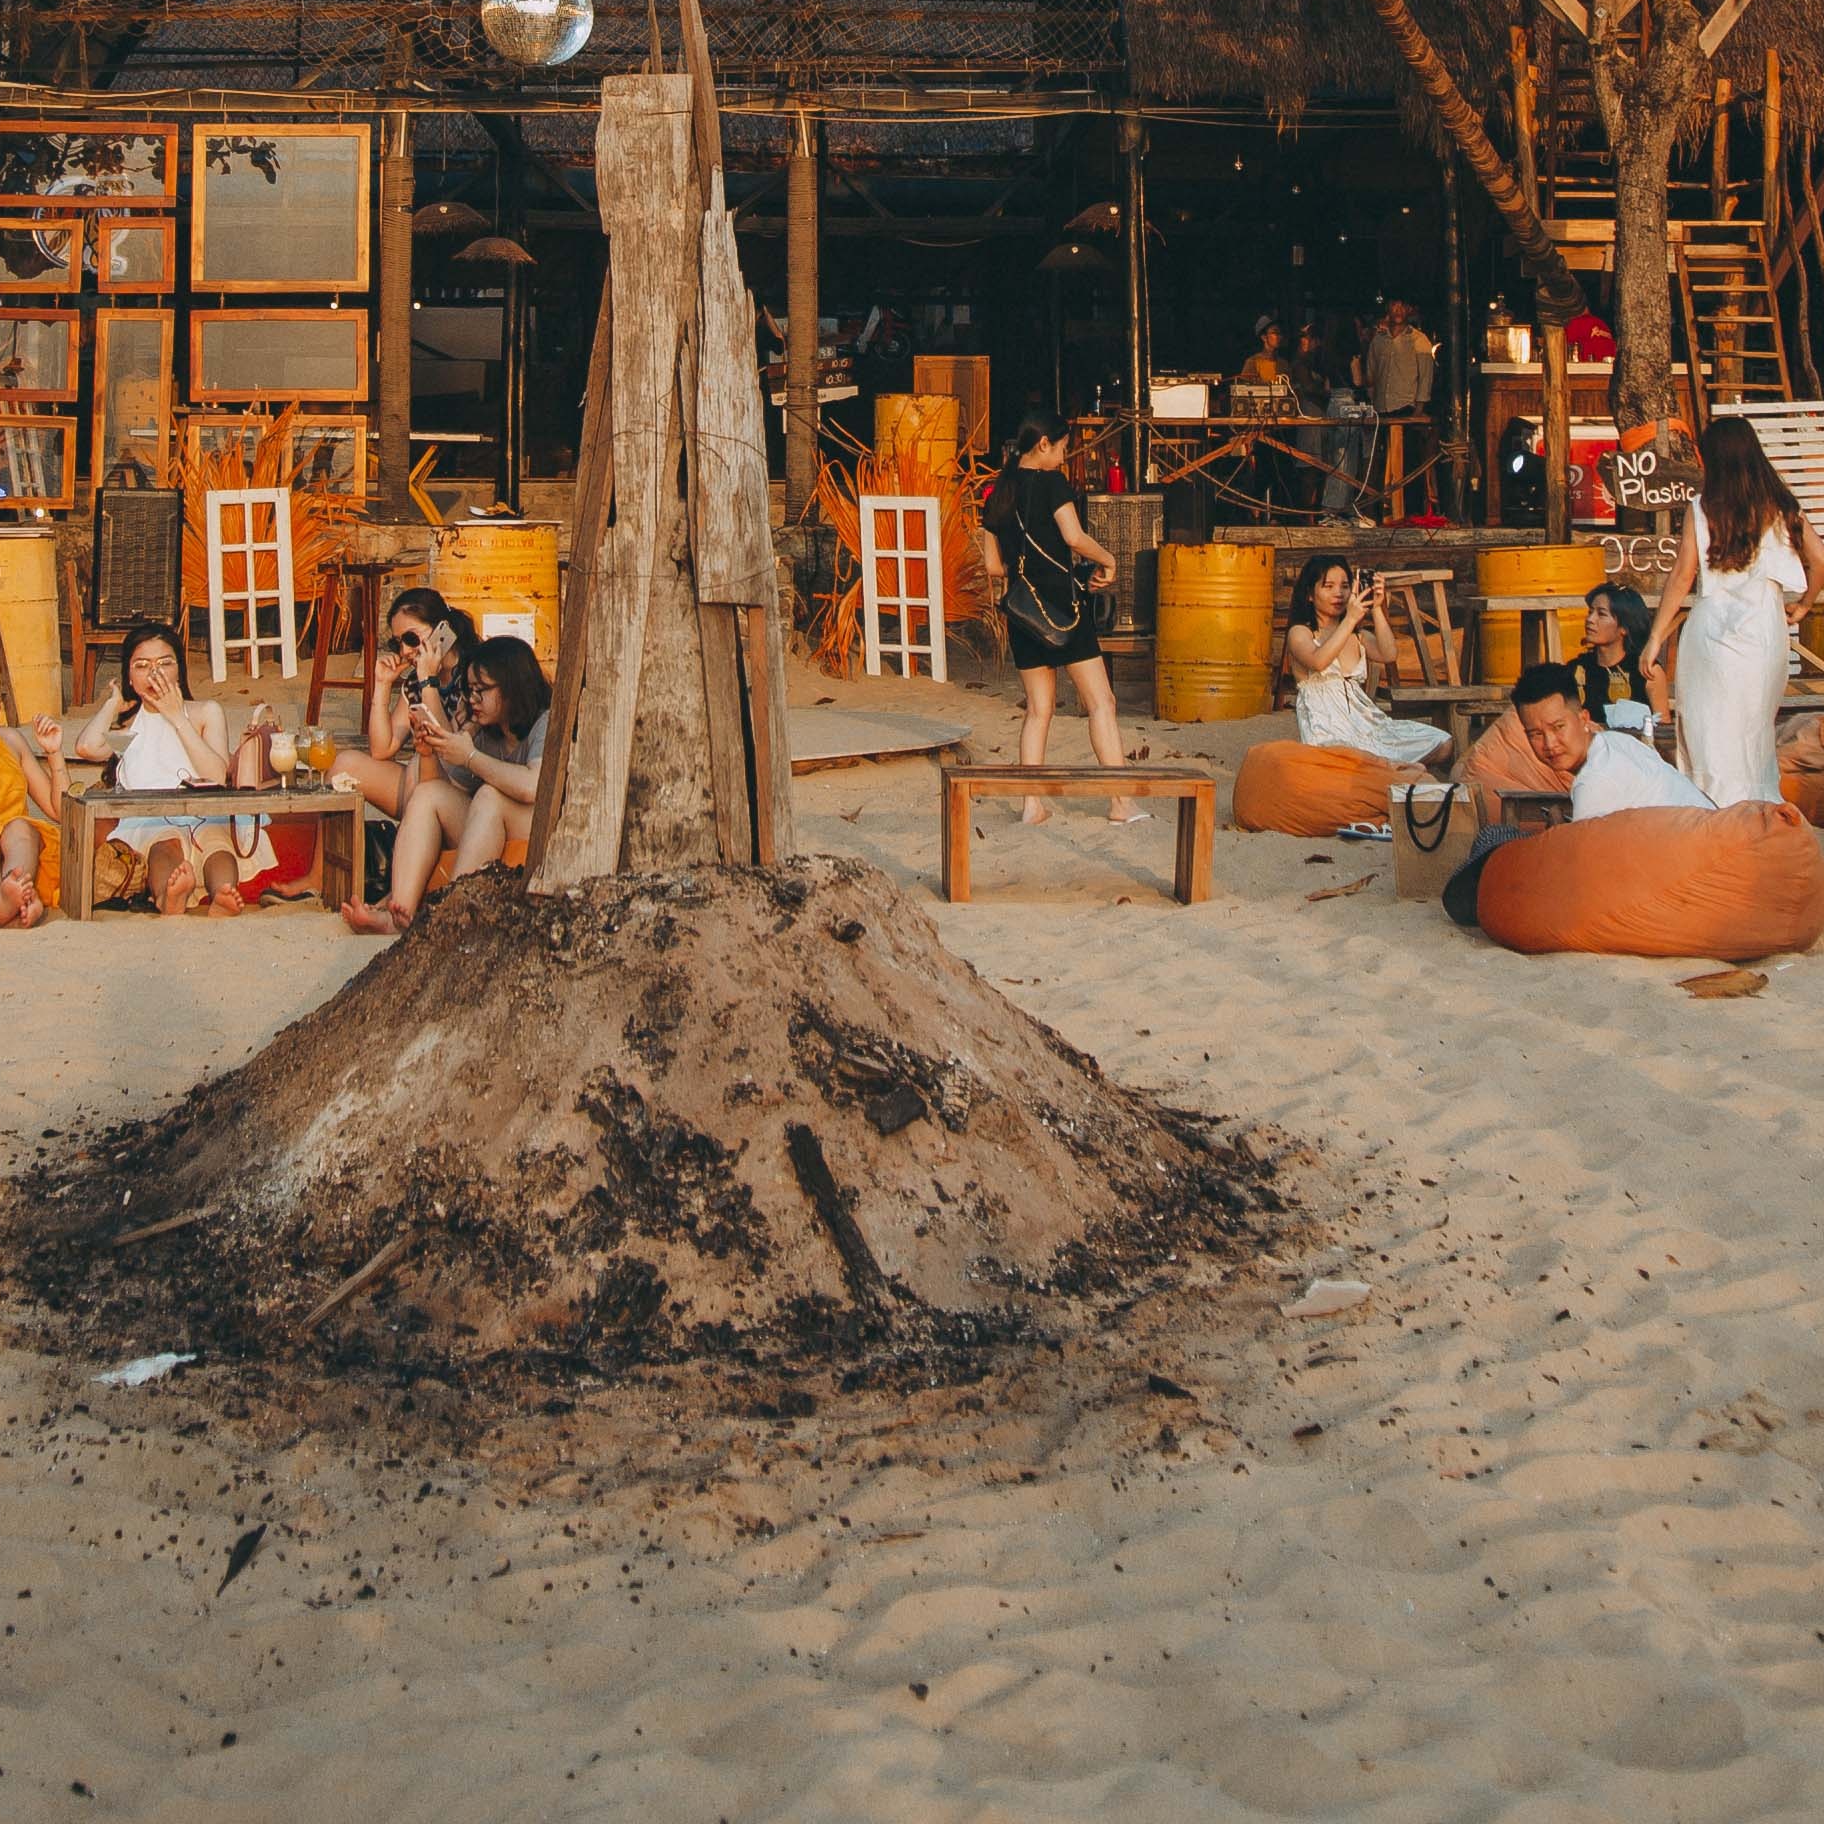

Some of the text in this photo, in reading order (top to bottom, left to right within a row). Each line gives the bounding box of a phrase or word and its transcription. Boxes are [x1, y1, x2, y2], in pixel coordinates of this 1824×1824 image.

[1616, 450, 1657, 477] NO
[1618, 477, 1698, 506] Plastic
[1599, 535, 1678, 573] OCS
